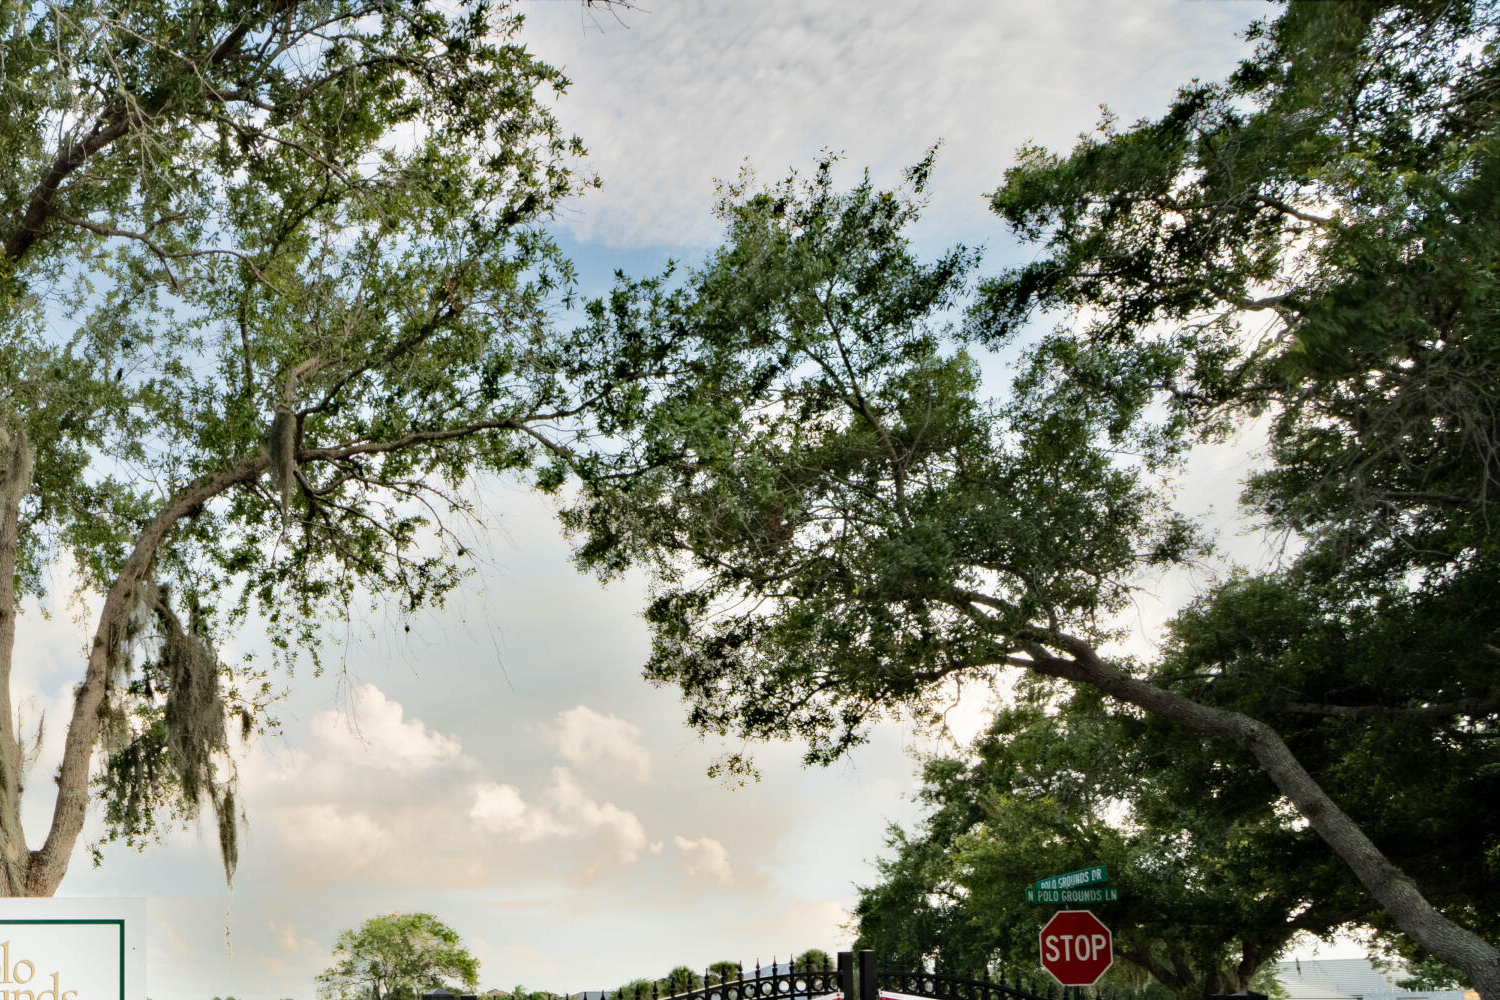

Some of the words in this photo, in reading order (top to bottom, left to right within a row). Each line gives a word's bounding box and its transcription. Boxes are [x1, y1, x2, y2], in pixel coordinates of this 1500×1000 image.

[1058, 872, 1089, 888] GROUNDS
[1092, 868, 1102, 880] DR
[1028, 890, 1034, 902] N
[1038, 890, 1059, 902] POLO
[1062, 890, 1102, 902] GROUNDS
[1106, 890, 1116, 900] LN
[1045, 934, 1107, 962] STOP
